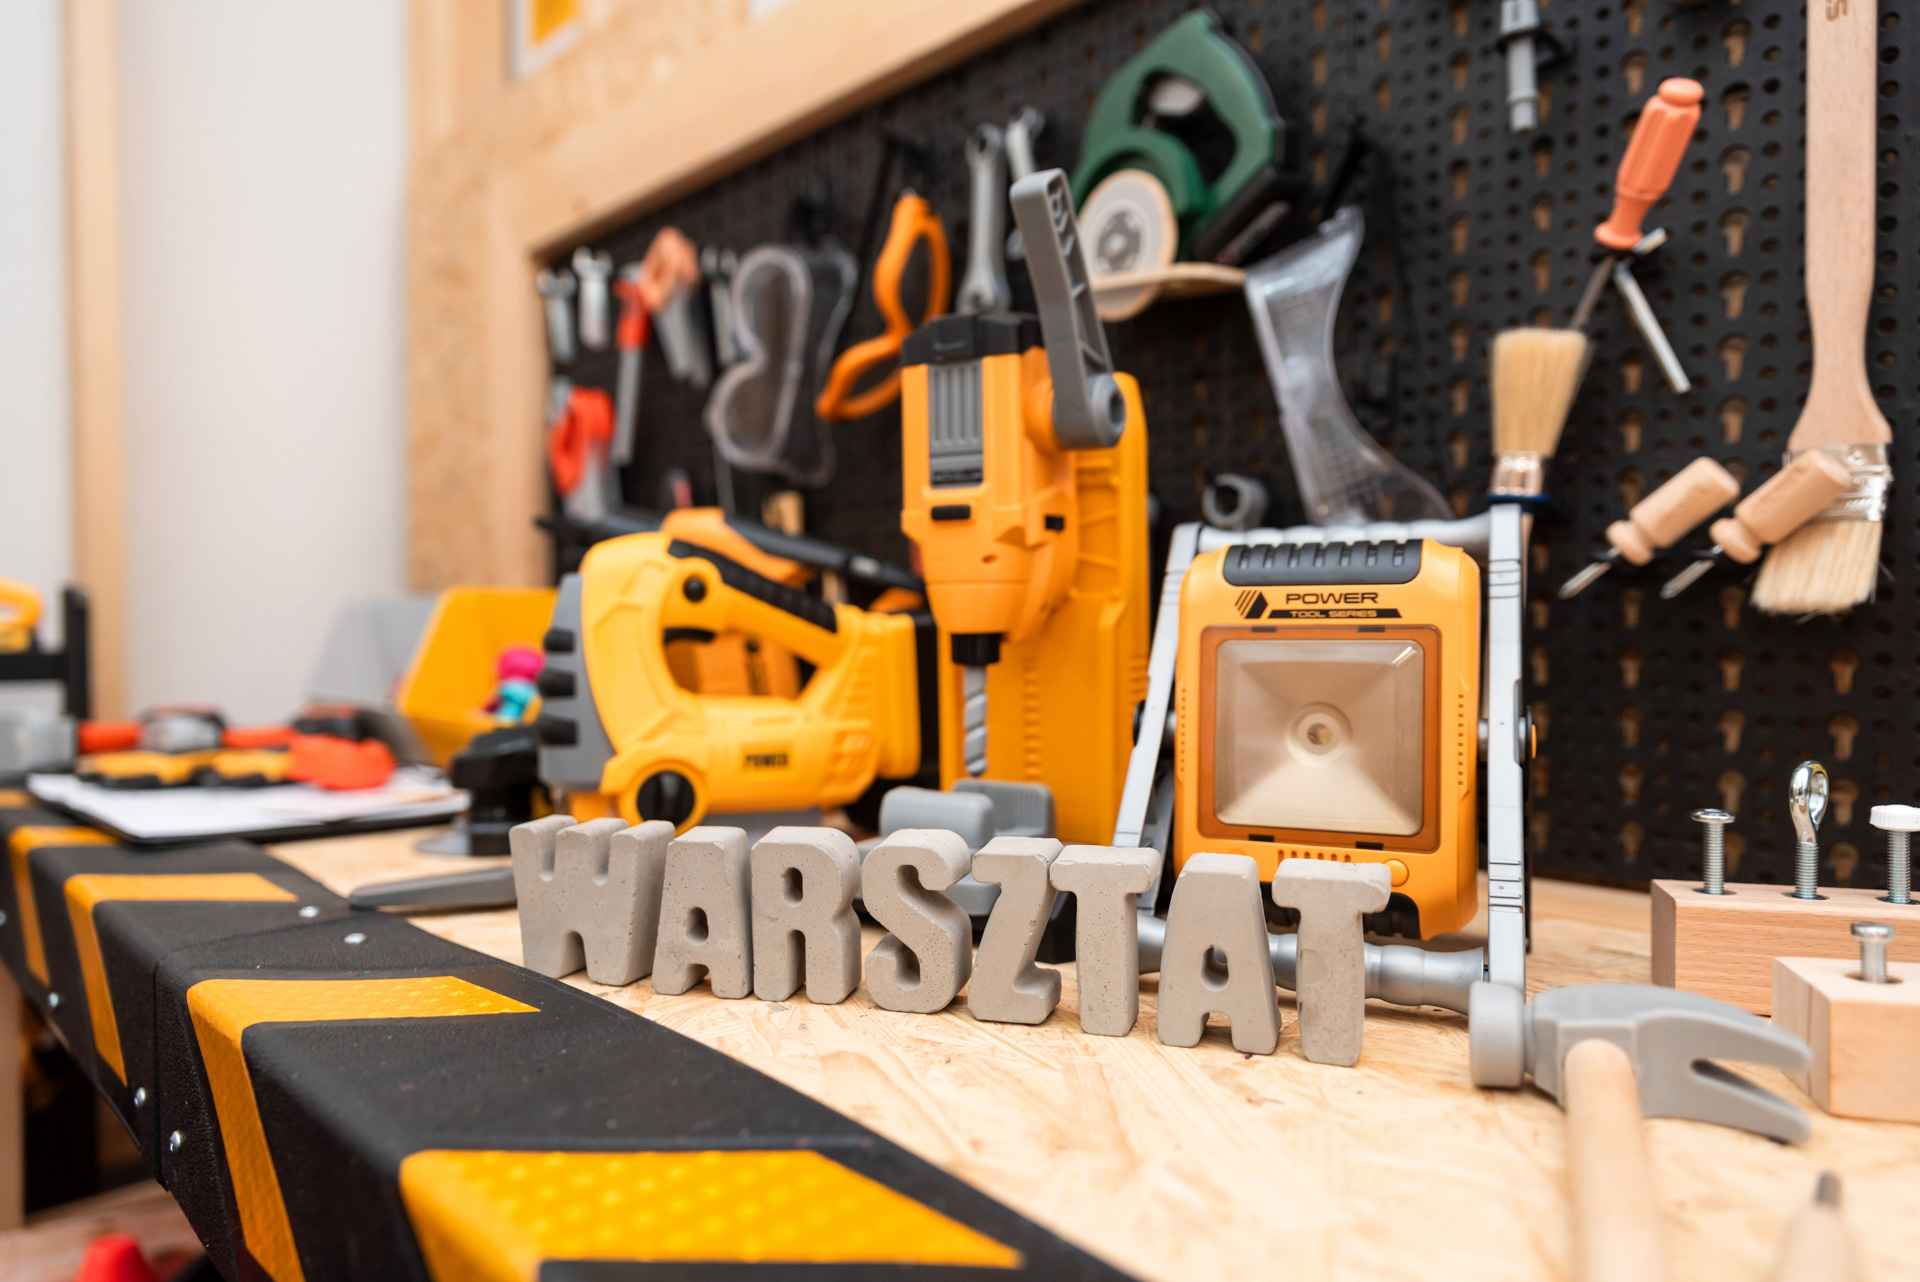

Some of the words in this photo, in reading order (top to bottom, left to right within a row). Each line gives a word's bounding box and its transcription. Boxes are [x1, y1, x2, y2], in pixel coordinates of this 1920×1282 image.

[1285, 592, 1379, 605] POWER
[1290, 610, 1327, 618] TOOL
[1328, 609, 1377, 618] SERIES
[509, 813, 1391, 1067] WARSZTAT
